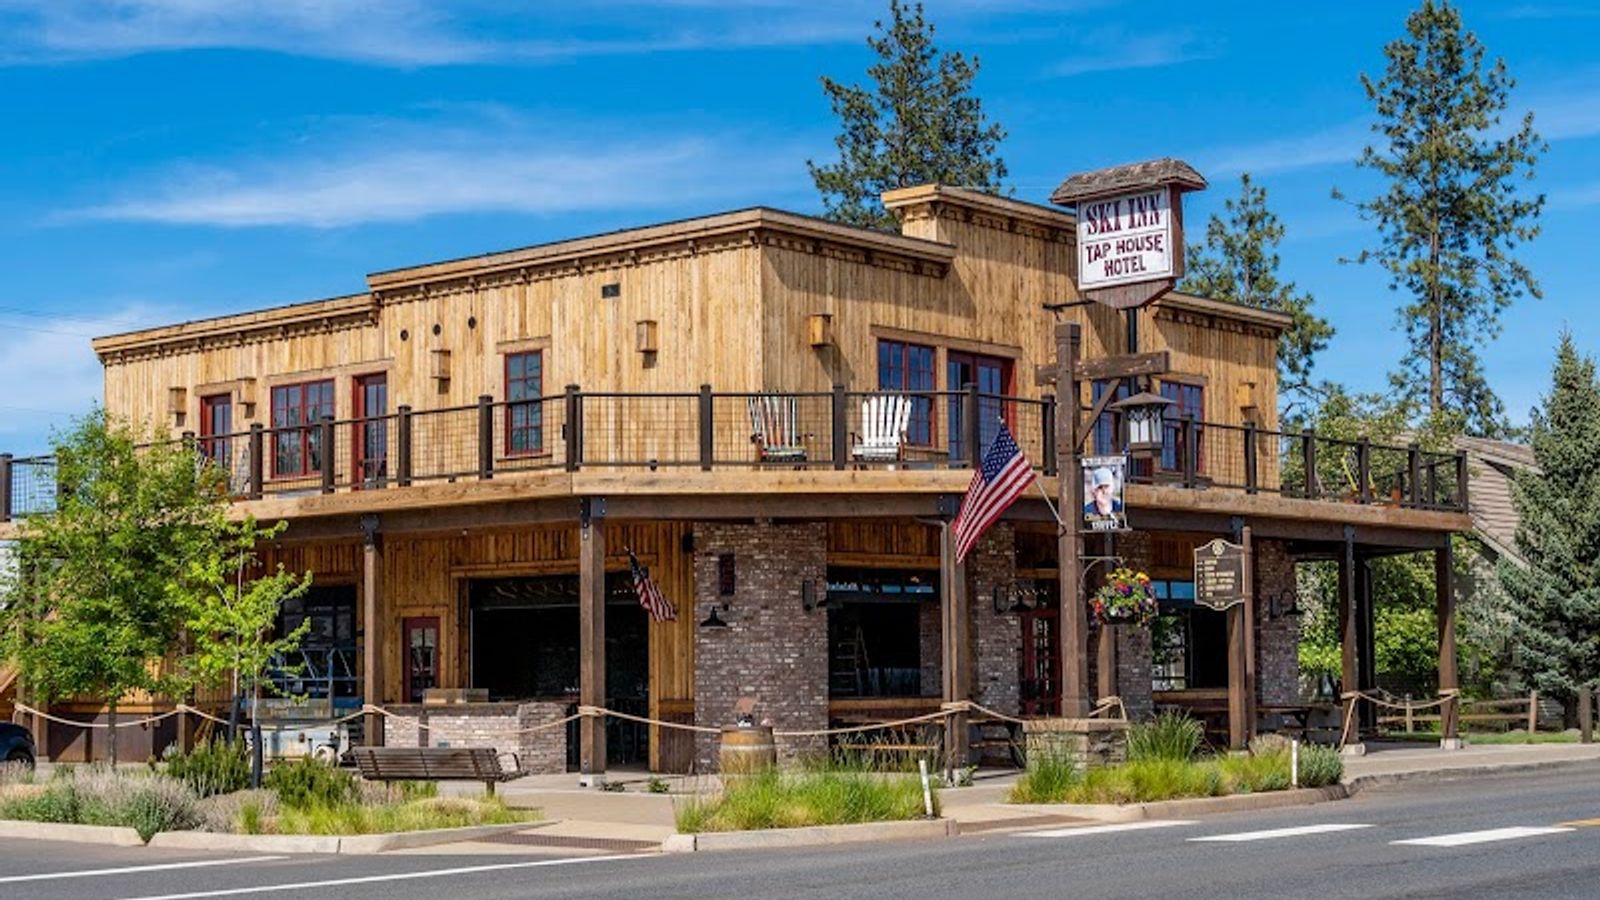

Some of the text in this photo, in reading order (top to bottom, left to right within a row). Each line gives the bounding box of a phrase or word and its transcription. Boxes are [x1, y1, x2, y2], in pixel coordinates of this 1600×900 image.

[1086, 194, 1160, 235] SKI INN
[1086, 234, 1164, 264] TAP HOUSE
[1104, 255, 1147, 277] HOTEL
